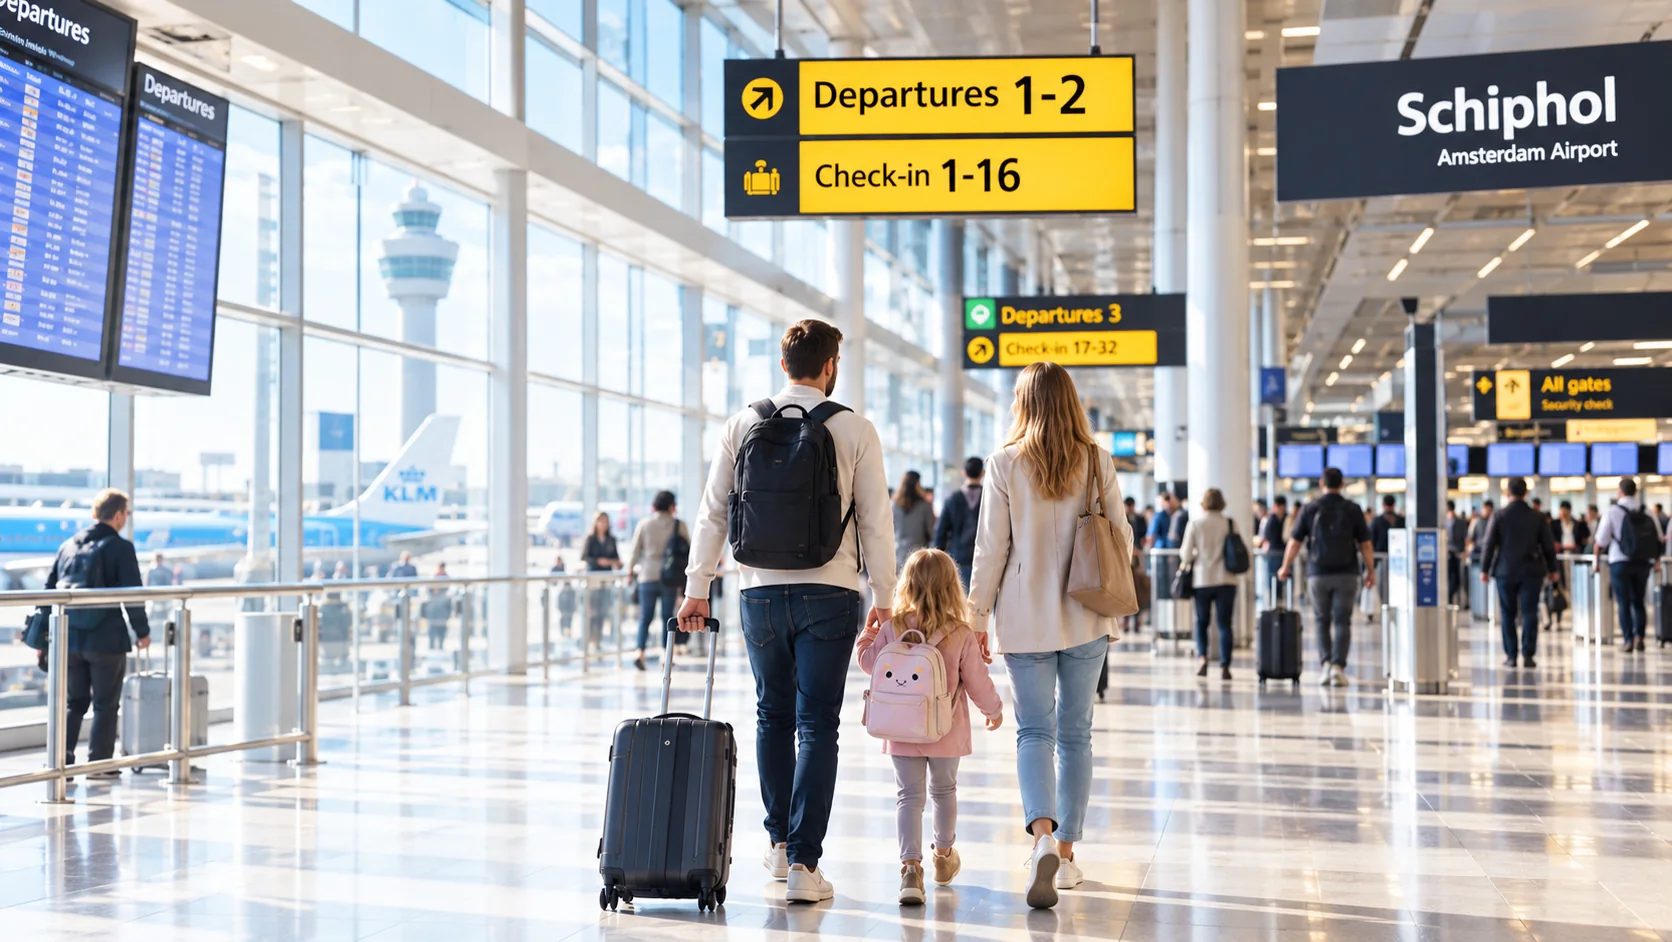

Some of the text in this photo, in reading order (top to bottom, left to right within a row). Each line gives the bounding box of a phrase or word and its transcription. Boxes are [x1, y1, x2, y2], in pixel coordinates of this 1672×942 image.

[144, 73, 215, 120] Departures
[814, 74, 1087, 115] Departures 1-2
[1397, 75, 1617, 140] Schiphol
[1437, 140, 1618, 166] Amsterdam Airport
[815, 157, 1022, 193] Check-in 1-16
[1001, 303, 1122, 328] Departures 3
[1006, 340, 1118, 356] Check-in 17-32
[1541, 375, 1612, 396] All gates
[1541, 397, 1614, 413] Security check
[384, 486, 437, 501] KLM
